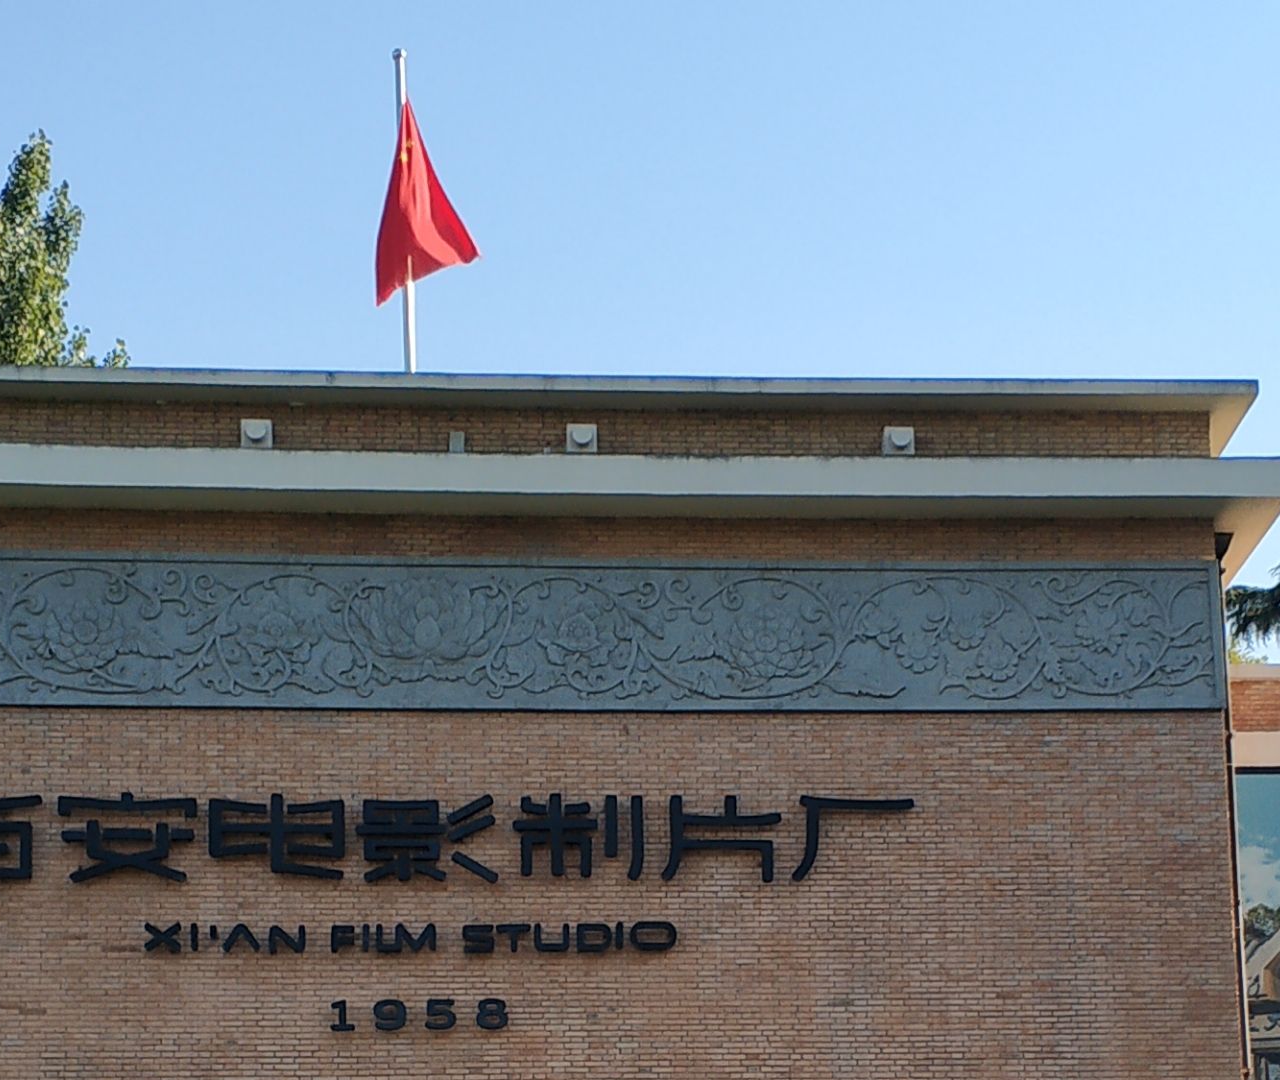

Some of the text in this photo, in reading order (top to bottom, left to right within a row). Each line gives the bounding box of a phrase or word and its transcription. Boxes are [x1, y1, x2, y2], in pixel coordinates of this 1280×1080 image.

[143, 920, 678, 954] XI'AN FILM STUDIO
[330, 998, 510, 1032] 1958
